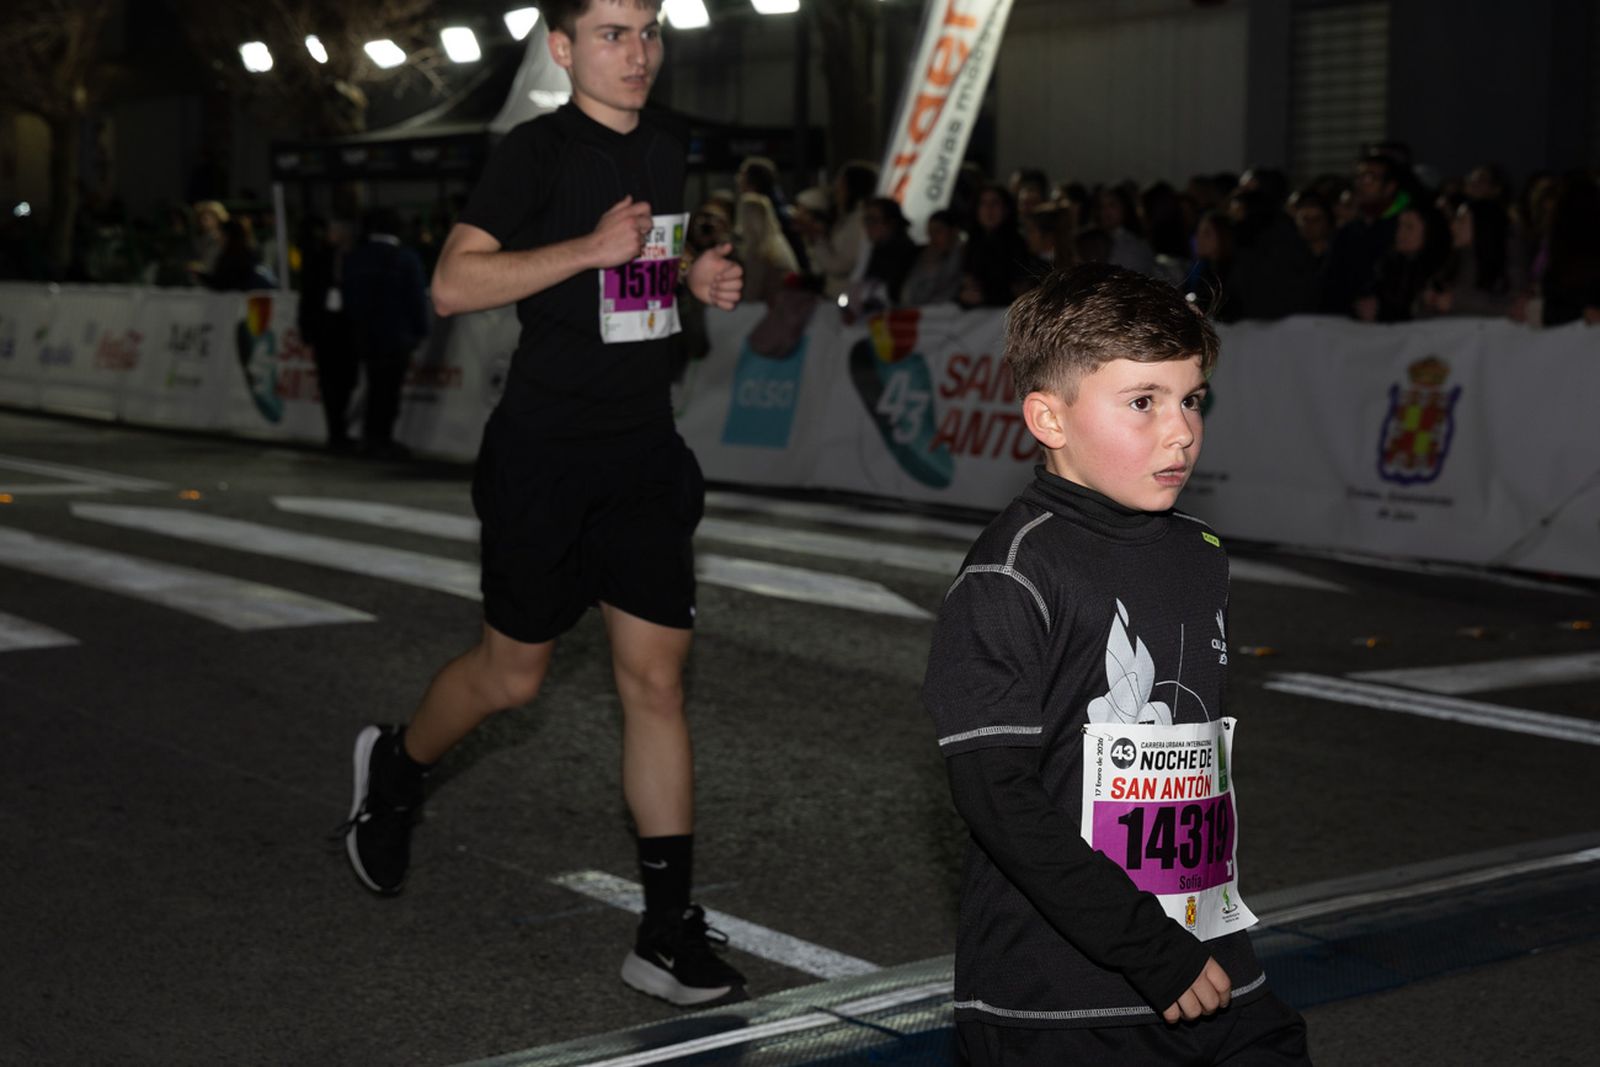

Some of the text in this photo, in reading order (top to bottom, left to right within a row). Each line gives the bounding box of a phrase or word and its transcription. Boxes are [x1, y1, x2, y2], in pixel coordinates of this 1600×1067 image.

[878, 370, 929, 443] 43
[1111, 744, 1135, 761] 43
[1140, 741, 1165, 749] CARRERA
[1166, 740, 1185, 749] URBANA
[1096, 756, 1104, 767] de
[1140, 748, 1212, 770] NOCHE DE
[1095, 767, 1103, 787] Enero
[1111, 776, 1158, 800] SAN
[1161, 769, 1212, 799] ANTÓN
[1095, 788, 1102, 797] 17
[1118, 799, 1229, 870] 14319
